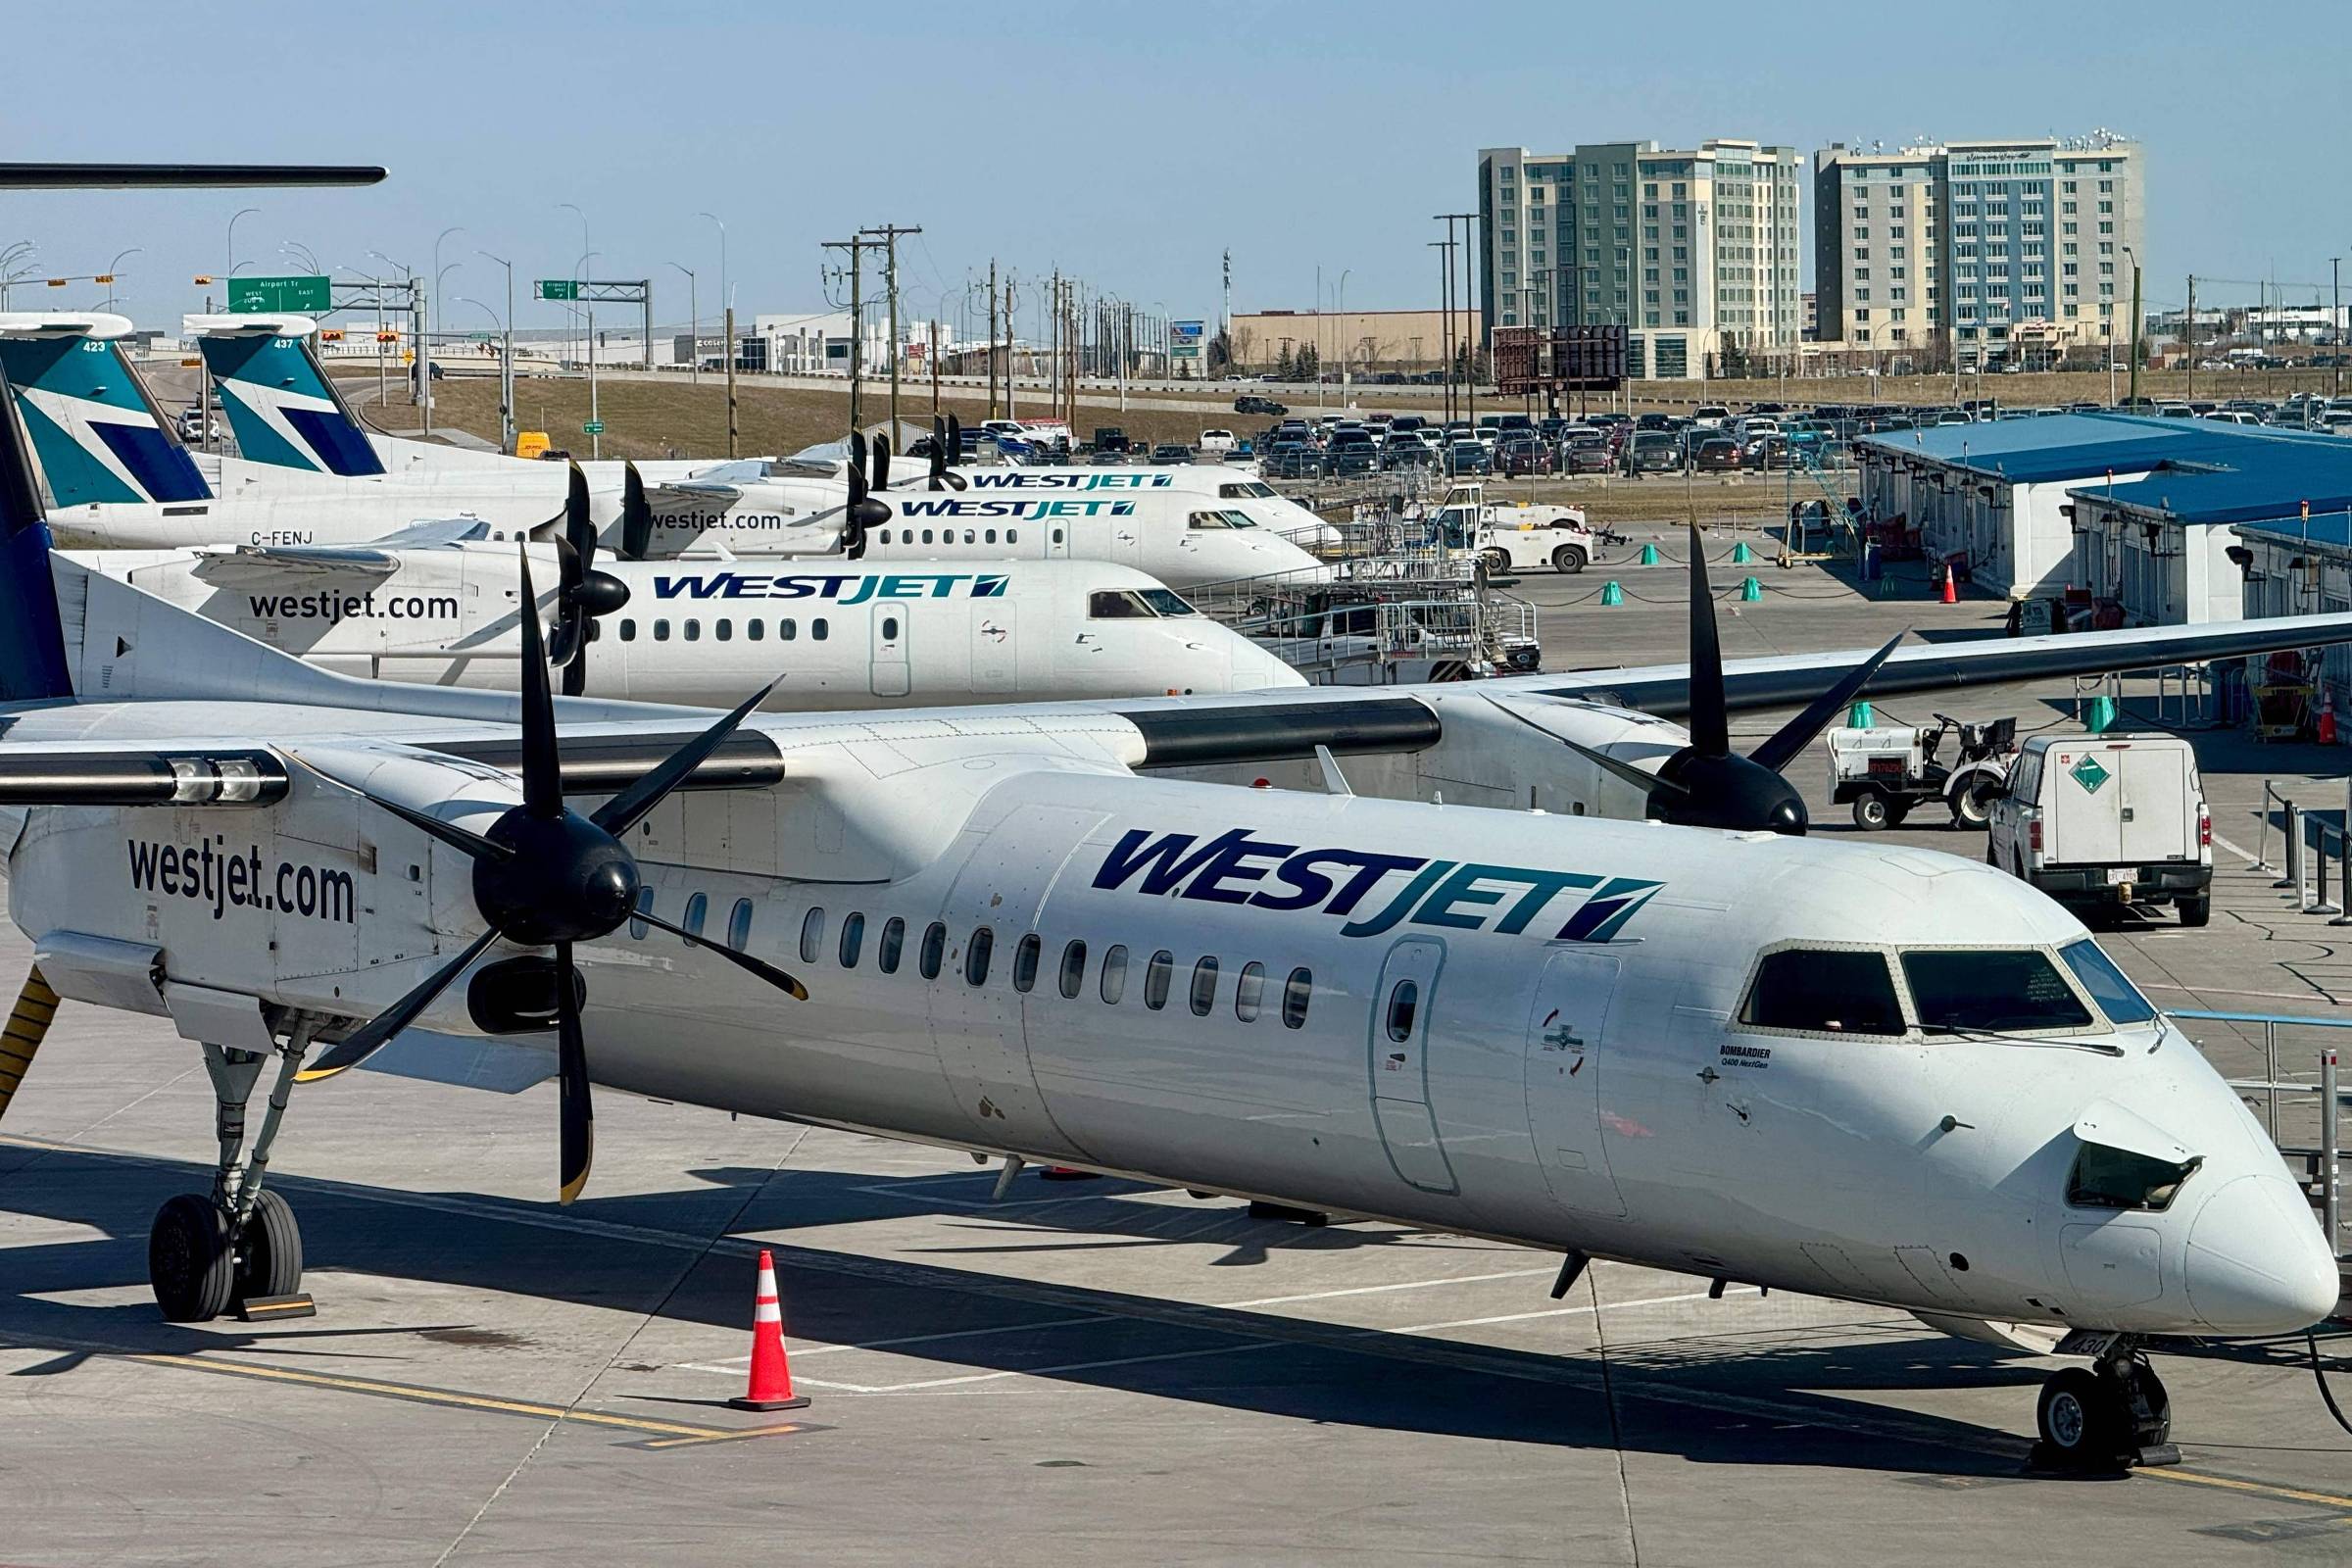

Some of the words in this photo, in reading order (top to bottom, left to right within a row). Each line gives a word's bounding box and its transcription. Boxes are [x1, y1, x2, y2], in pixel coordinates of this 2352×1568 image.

[83, 341, 106, 352] 423
[274, 339, 293, 349] 437
[973, 473, 1154, 490] WESTJET
[902, 499, 1112, 520] WESTJET
[651, 510, 781, 534] westjet.com
[251, 531, 313, 546] C-FENJ
[653, 572, 972, 605] WESTJET
[249, 589, 458, 625] westjet.com
[127, 835, 354, 924] westjet.com
[1091, 828, 1606, 938] WESTJET
[1720, 1045, 1771, 1058] BOMBARDIER
[1739, 1059, 1768, 1068] NextGen
[2070, 1338, 2107, 1353] 430
